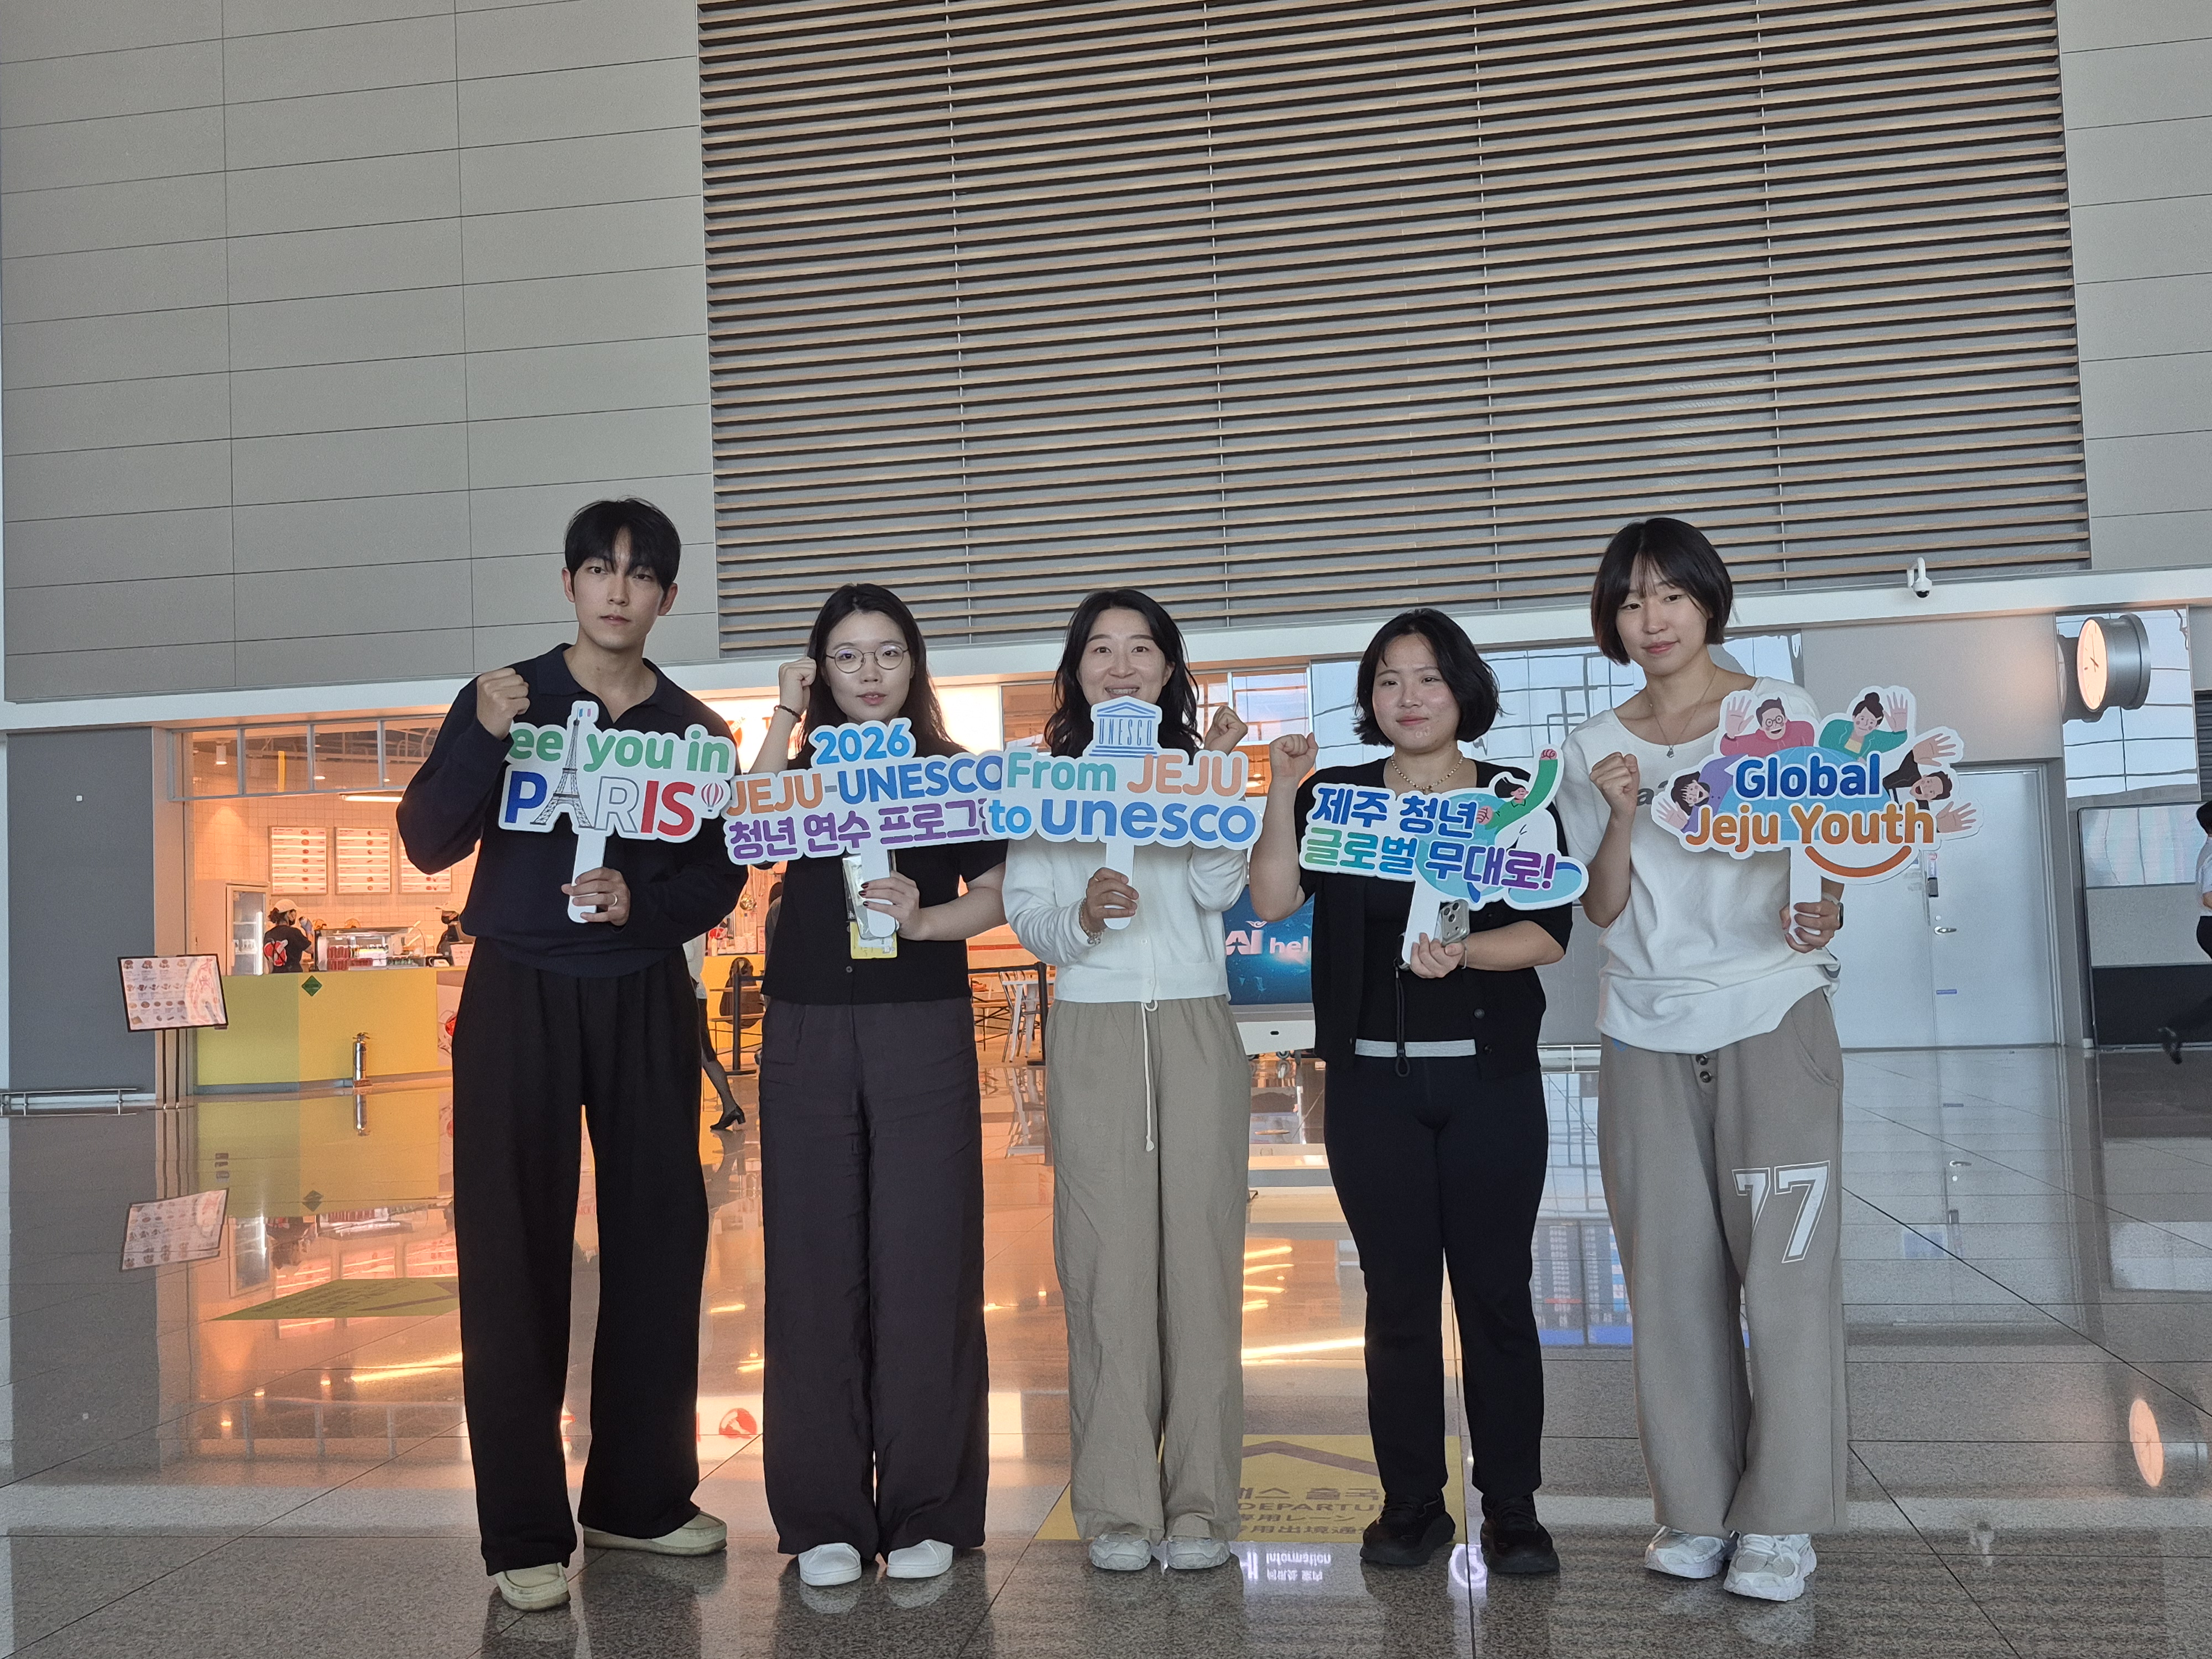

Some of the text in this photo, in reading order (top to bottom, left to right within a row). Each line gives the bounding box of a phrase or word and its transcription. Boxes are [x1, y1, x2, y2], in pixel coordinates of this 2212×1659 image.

[509, 728, 729, 774] ee you in
[814, 723, 911, 764] 2026
[1098, 718, 1152, 747] UNESCO
[727, 755, 1002, 816] JEJU-UNESCO
[1007, 752, 1243, 796] From JEJU
[1735, 753, 1880, 799] Global
[504, 770, 697, 837] PARIS
[989, 798, 1256, 843] to unesco
[1311, 786, 1480, 839] 제주 청년
[1685, 802, 1934, 852] Jeju Youth
[729, 797, 990, 860] 청년 연수 프로그
[1304, 826, 1558, 891] 글로벌 무대로!
[1225, 930, 1310, 956] AI hel
[1731, 1160, 1830, 1263] 77
